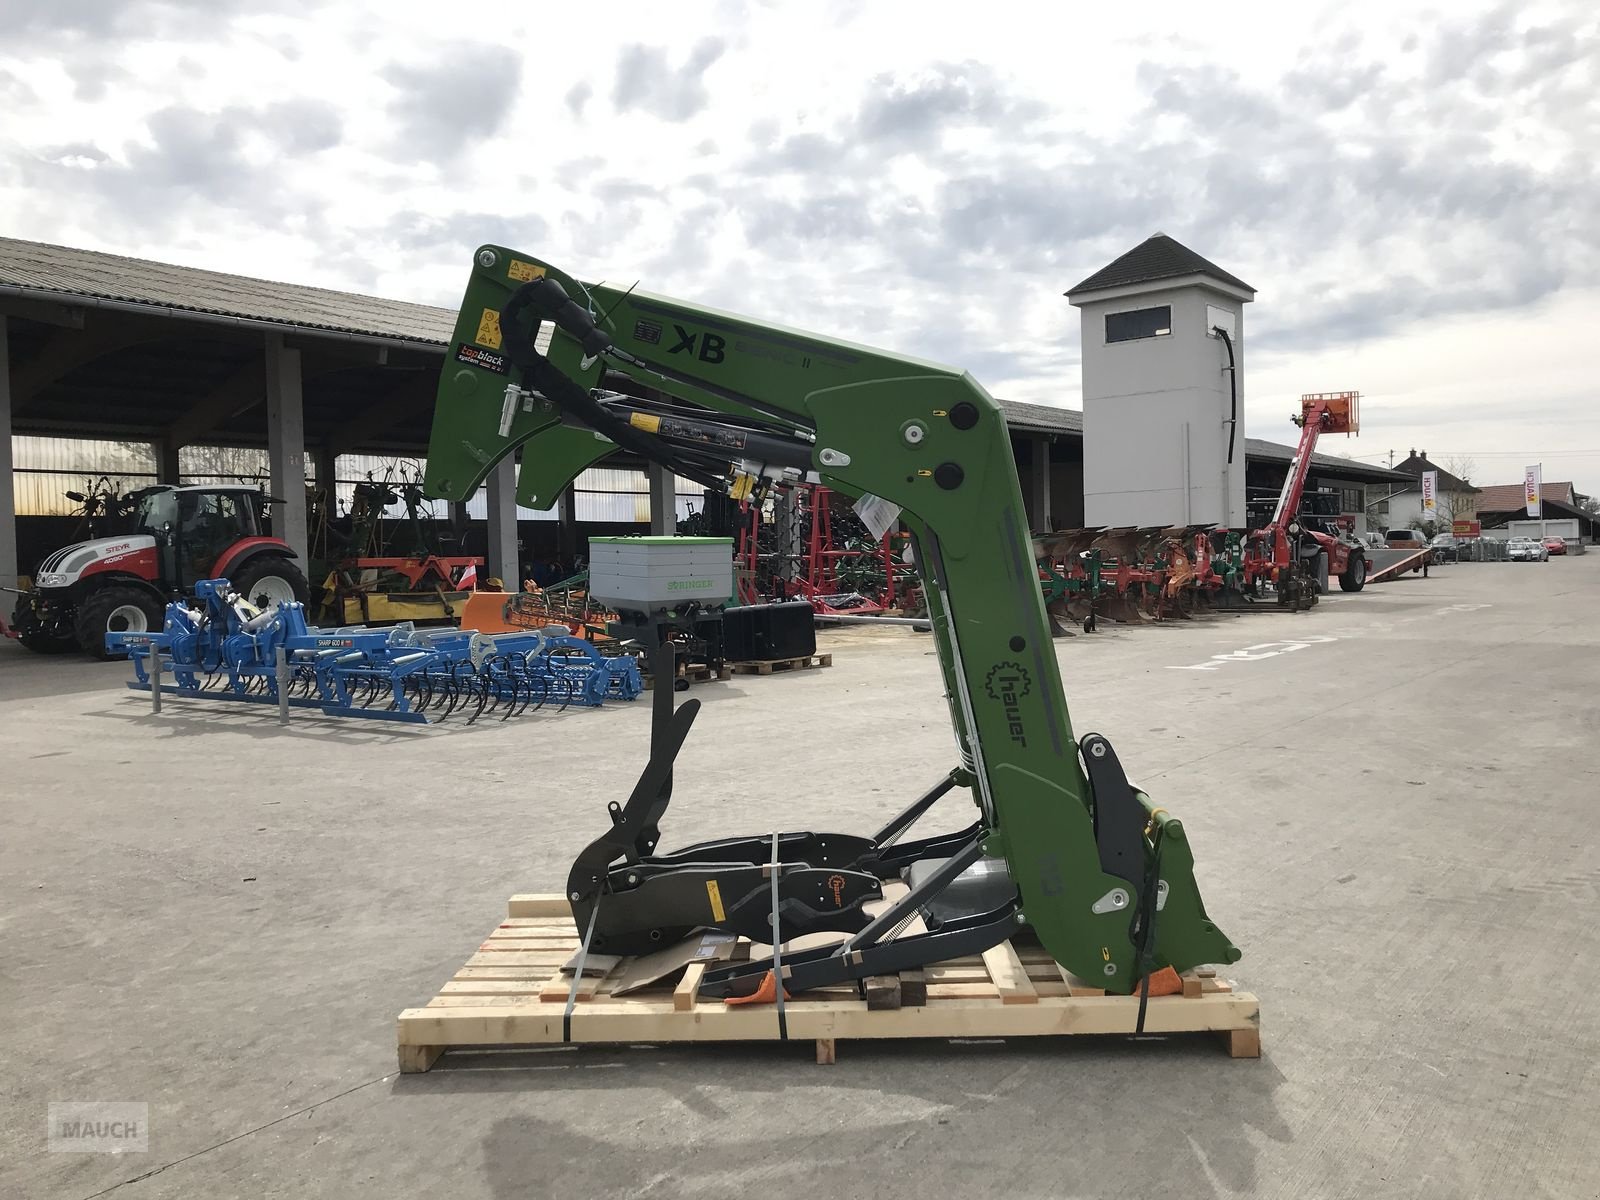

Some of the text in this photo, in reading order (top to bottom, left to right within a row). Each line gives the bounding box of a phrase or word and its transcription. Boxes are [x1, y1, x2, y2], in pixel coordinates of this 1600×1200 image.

[667, 324, 726, 364] XB
[458, 354, 480, 365] system
[461, 345, 504, 366] topblock
[105, 543, 131, 554] STEYR
[318, 639, 332, 647] SHARP
[999, 676, 1028, 748] hauer
